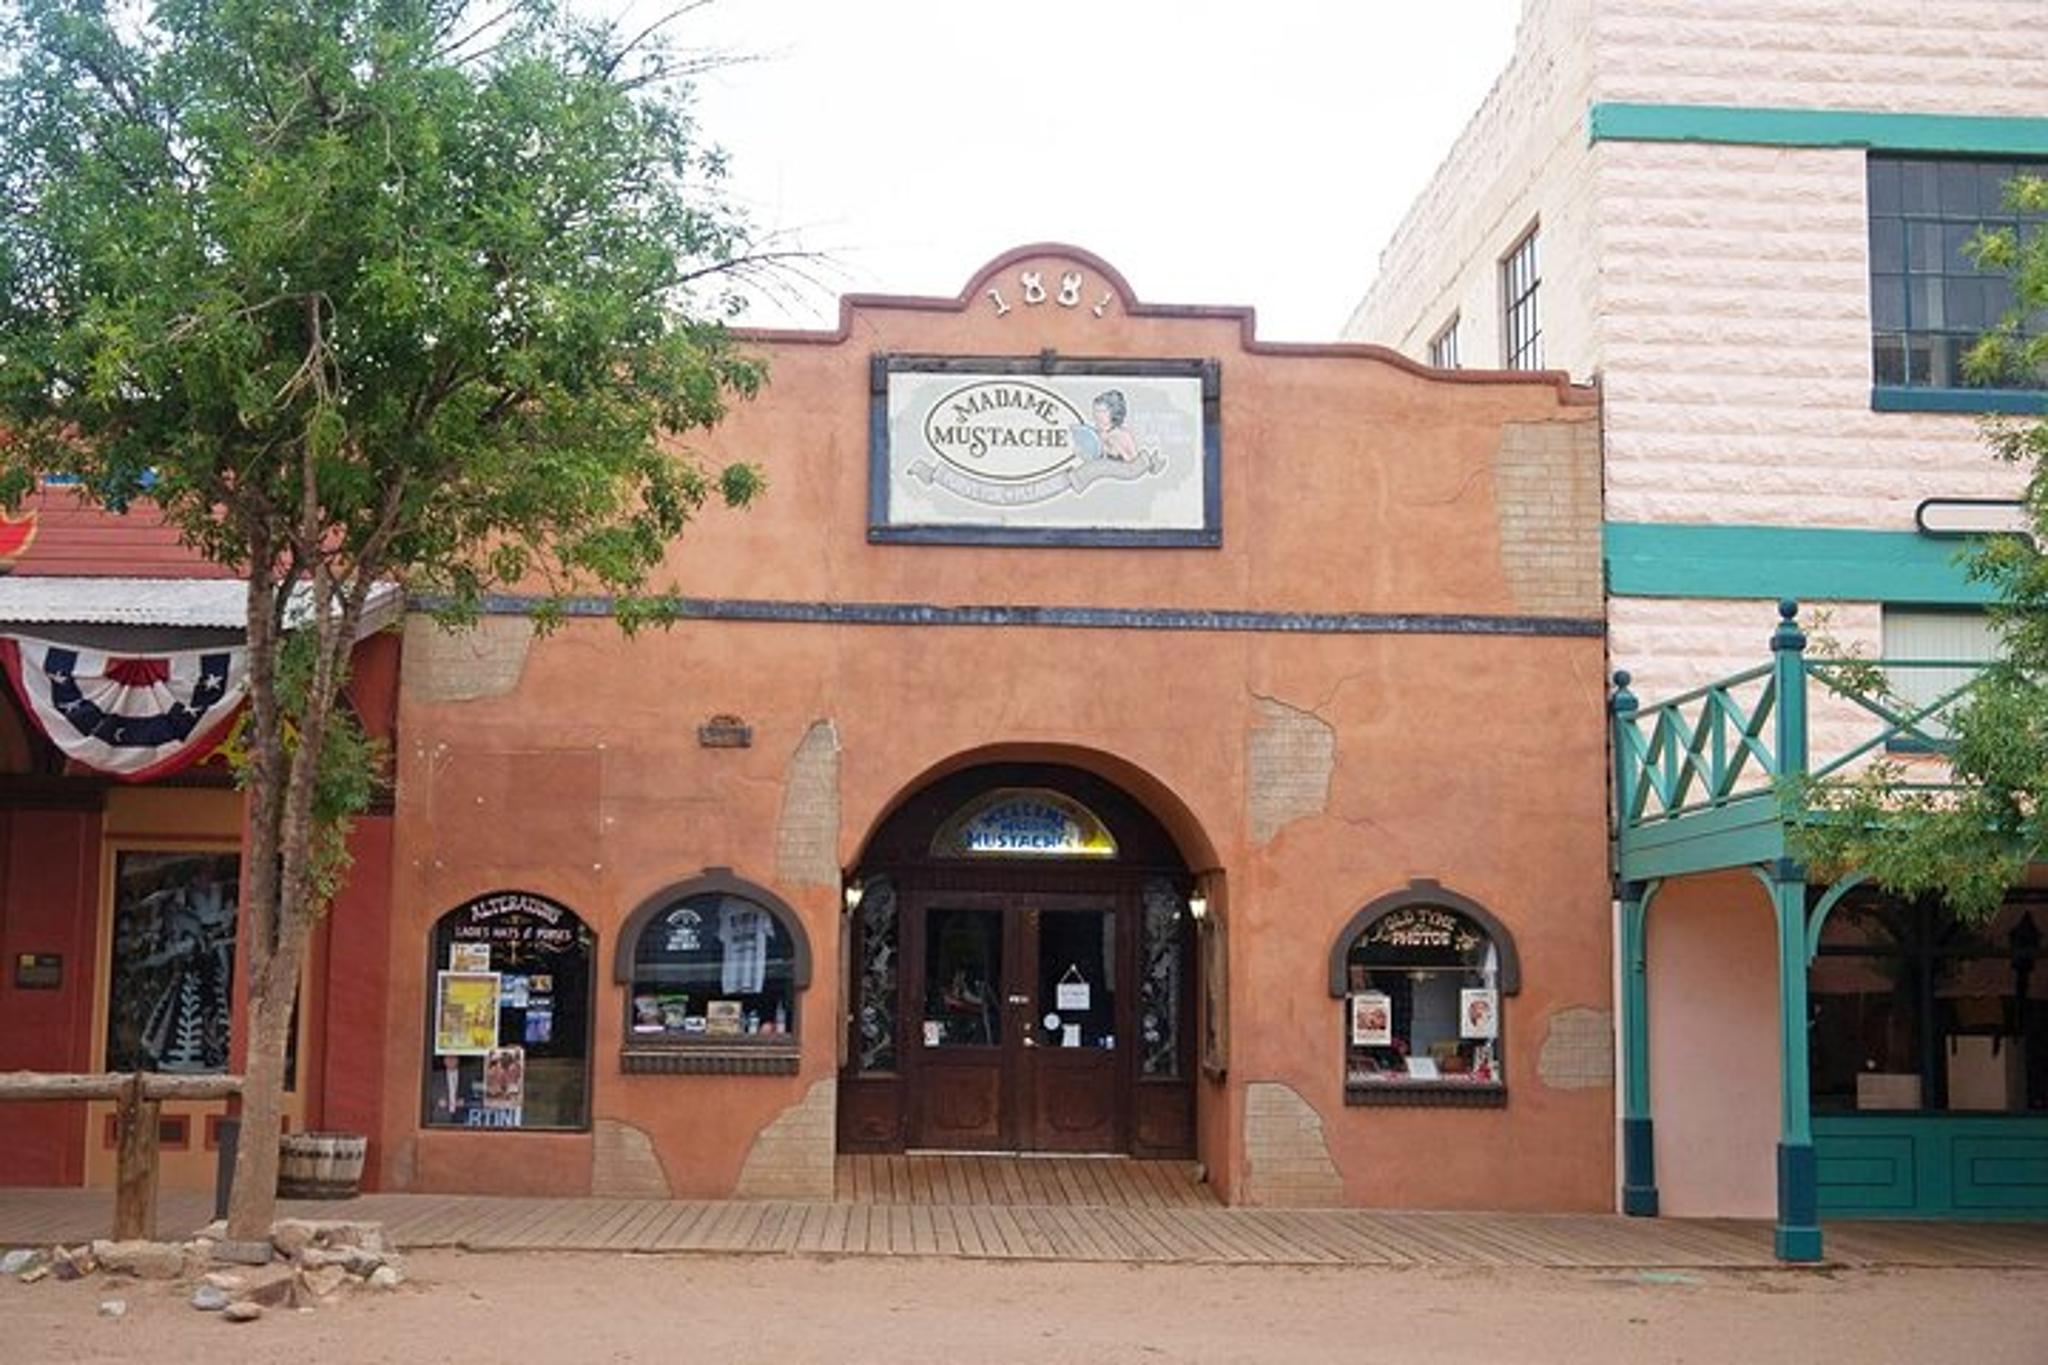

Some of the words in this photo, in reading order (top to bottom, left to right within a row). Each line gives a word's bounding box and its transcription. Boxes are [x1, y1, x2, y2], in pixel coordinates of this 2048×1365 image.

[953, 388, 1058, 425] MADAME
[934, 426, 1068, 458] MUSTACHE
[1391, 931, 1451, 946] PHOTOS
